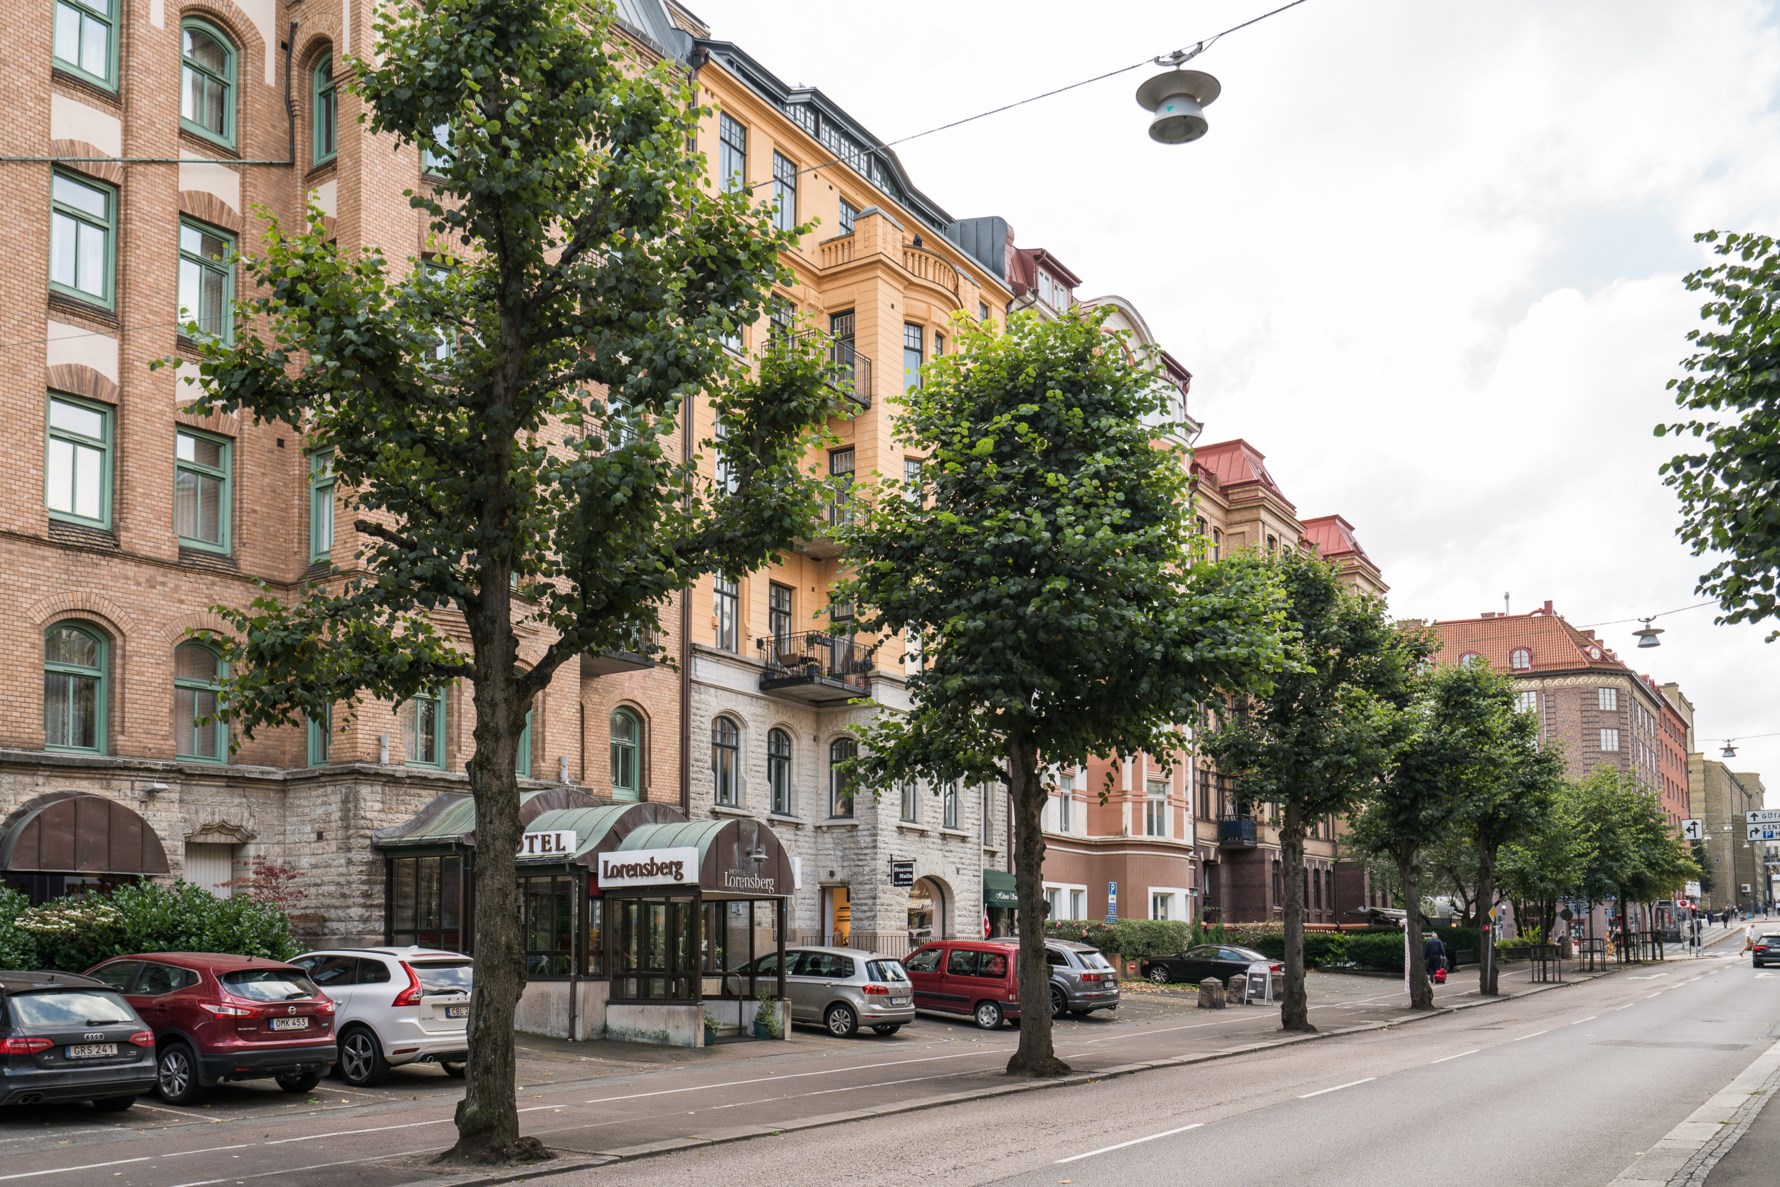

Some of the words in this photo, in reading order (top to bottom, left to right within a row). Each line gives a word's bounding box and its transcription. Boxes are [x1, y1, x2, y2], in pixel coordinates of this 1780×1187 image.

[602, 856, 684, 881] Lorensberg
[728, 868, 746, 876] HOTEL
[724, 871, 775, 894] Lorensberg
[275, 1019, 290, 1028] OMK
[292, 1018, 306, 1027] 453
[74, 1045, 93, 1056] GRS
[96, 1044, 114, 1054] 241
